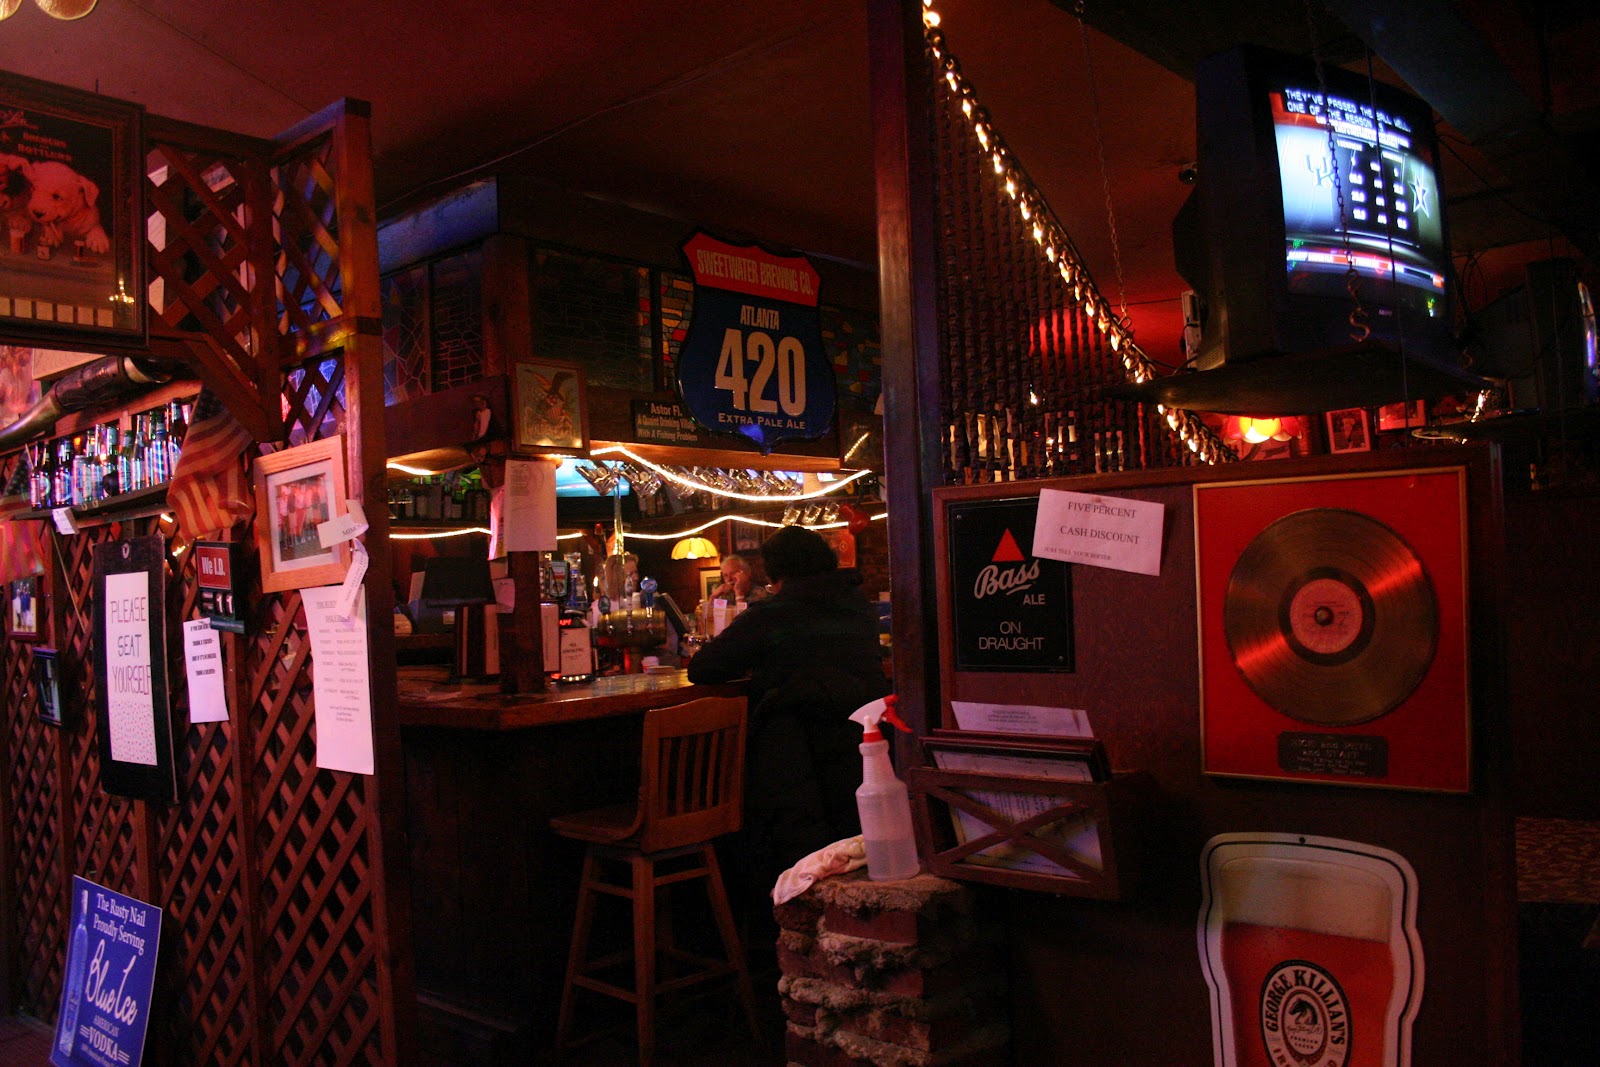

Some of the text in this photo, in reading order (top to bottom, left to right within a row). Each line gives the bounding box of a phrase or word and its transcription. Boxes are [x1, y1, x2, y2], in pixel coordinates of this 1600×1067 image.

[1285, 89, 1324, 106] THEY'VE
[1326, 96, 1357, 114] PASSED
[1360, 106, 1374, 119] THE
[1286, 102, 1306, 114] ONE
[1309, 104, 1320, 115] OF
[696, 249, 815, 295] SWEETWATER BREWING CO.
[739, 304, 780, 331] ATLANTA
[713, 327, 807, 417] 420
[650, 402, 671, 415] Astor
[637, 427, 650, 438] With
[656, 430, 676, 442] Fishing
[660, 416, 680, 431] Drinking
[1067, 501, 1137, 519] FIVE PERCENT
[1059, 525, 1140, 545] CASH DISCOUNT
[201, 556, 213, 576] We
[1058, 548, 1072, 556] TELL
[1073, 550, 1089, 558] YOUR
[1090, 552, 1111, 561] SERVER
[973, 559, 1042, 600] Bass
[110, 597, 147, 624] PLEASE
[1022, 593, 1046, 606] ALE
[999, 621, 1022, 635] ON
[117, 634, 142, 657] SEAT
[978, 637, 1045, 651] DRAUGHT
[111, 665, 152, 695] YOURSELF
[96, 893, 147, 928] The Rusty Nail
[93, 913, 146, 956] Proudly Serving
[85, 938, 116, 1014] Blue
[114, 955, 138, 1026] Ice
[1265, 969, 1345, 1045] GEORGE KILLIAN'S
[89, 1026, 118, 1061] VODKA
